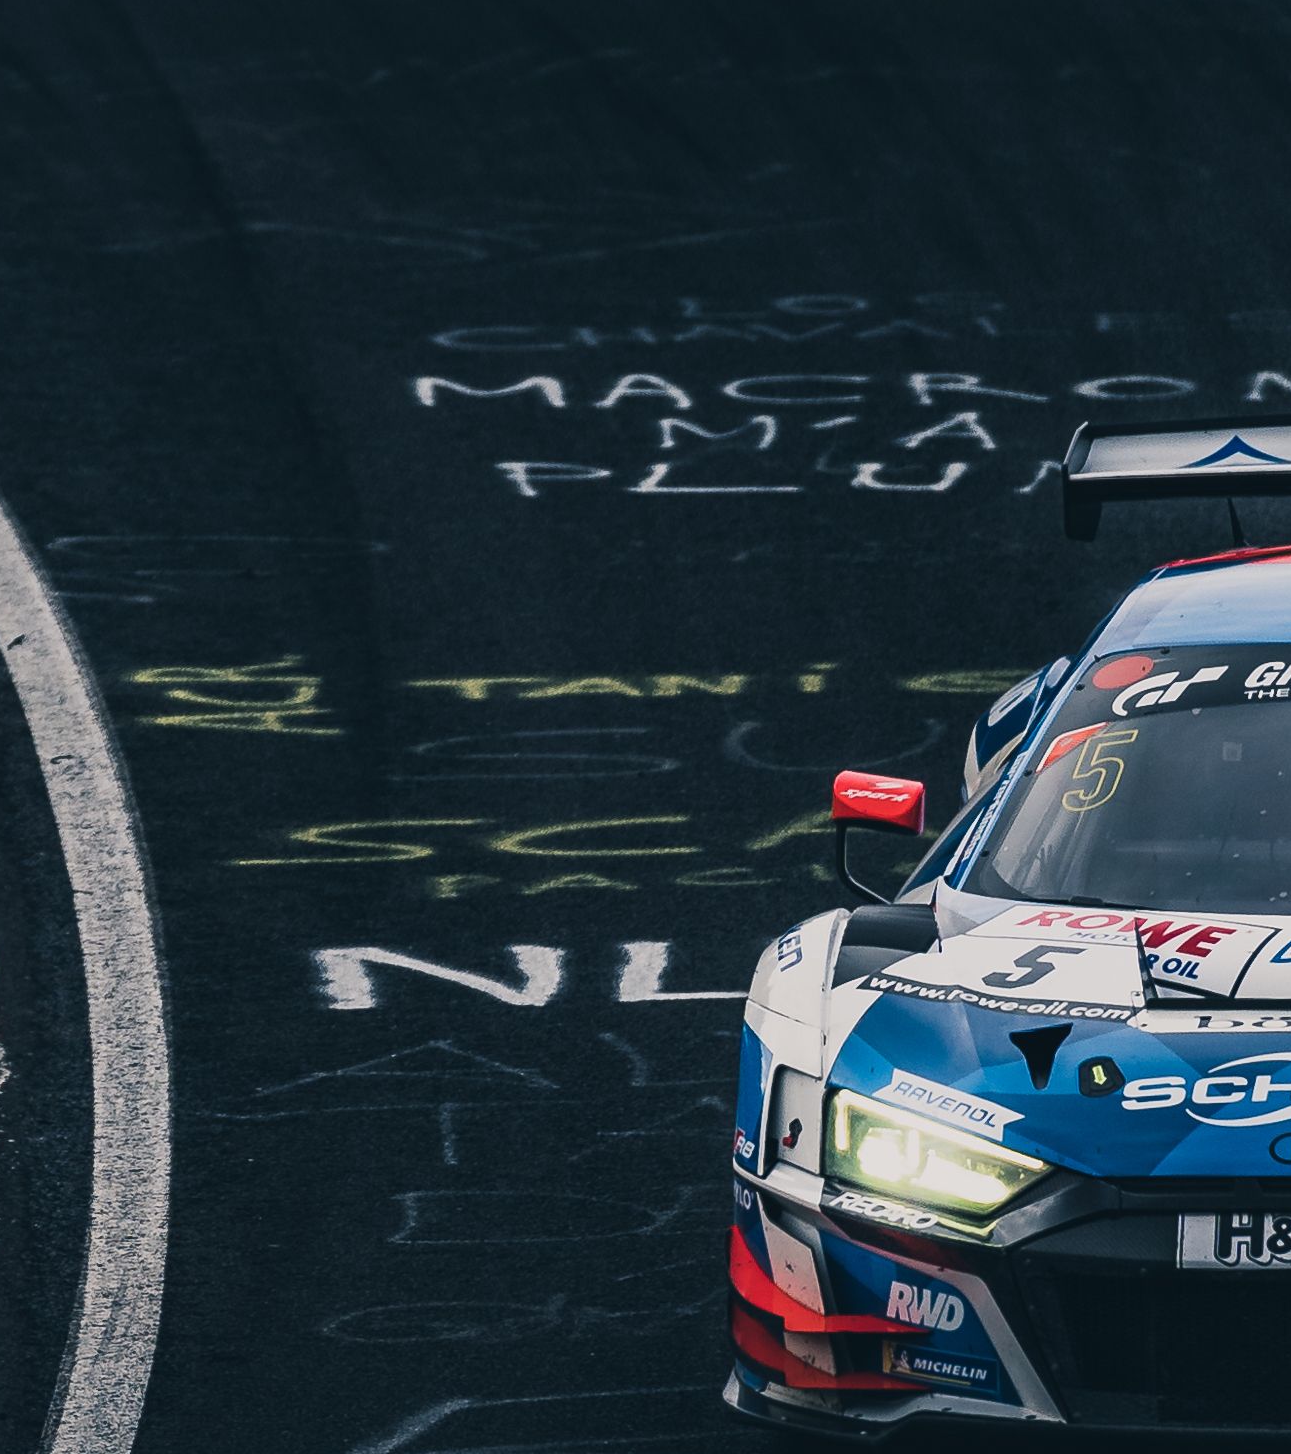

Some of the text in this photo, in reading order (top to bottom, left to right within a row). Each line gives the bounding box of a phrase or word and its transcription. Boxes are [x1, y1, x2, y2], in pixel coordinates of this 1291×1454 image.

[1244, 688, 1289, 700] THE
[1061, 729, 1139, 814] 5
[1014, 909, 1238, 959] ROWE
[982, 944, 1088, 990] 5
[1162, 957, 1200, 980] OIL
[869, 973, 1132, 1021] www.rowe-oil.com
[892, 1079, 997, 1128] RAVENOL
[828, 1191, 939, 1230] RECARO
[886, 1280, 965, 1332] RWD
[912, 1357, 988, 1382] MICHELIN
